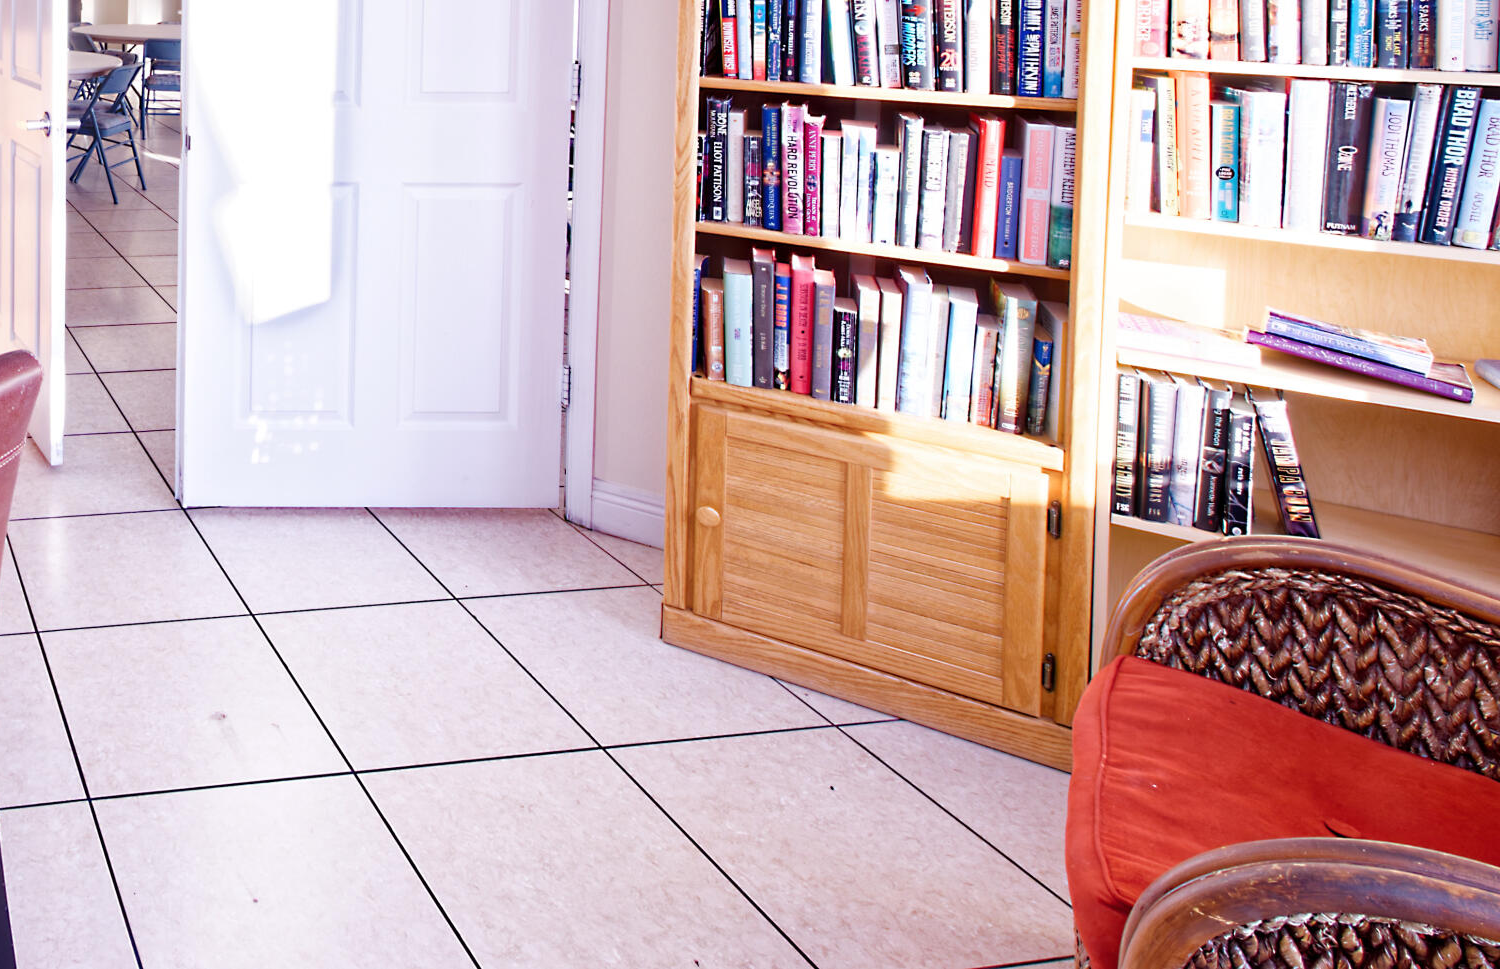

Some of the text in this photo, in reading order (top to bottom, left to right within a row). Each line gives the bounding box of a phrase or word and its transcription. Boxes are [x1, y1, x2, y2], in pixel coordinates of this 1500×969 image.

[1023, 10, 1042, 31] MICE
[1050, 5, 1060, 45] JAMES PATTERSON
[1358, 9, 1367, 27] SONG
[1418, 5, 1429, 31] SPARKS
[722, 22, 734, 52] DOWNSIZE
[804, 40, 815, 64] Lincoln
[902, 22, 916, 66] MURDERS
[997, 34, 1006, 73] DISAPPEAR
[1354, 34, 1362, 58] SPARKS
[1361, 29, 1371, 63] NICHOLAS
[1007, 51, 1015, 78] WOMEN
[716, 112, 727, 136] BONE
[1220, 108, 1234, 165] BRAD TAYLOR
[787, 135, 798, 161] HARD
[808, 130, 817, 172] ANNE PERRY
[1382, 112, 1403, 177] JODI THOMAS
[1435, 90, 1478, 228] BRAD THOR HIDDEN ORDER
[1477, 116, 1500, 179] BRAD THOR
[713, 141, 722, 202] ELIOT PATTISON
[984, 160, 996, 188] MAID
[1061, 132, 1077, 205] MATTHEW REILLY
[787, 163, 799, 219] REVOLUTION
[1006, 182, 1014, 215] BRIDGERTON
[767, 202, 776, 219] QUEEN
[1326, 222, 1356, 231] PUTNAM
[776, 303, 788, 327] ROBB
[1213, 417, 1224, 446] the Moon
[1115, 431, 1134, 498] PLEADING GUILTY
[1270, 439, 1312, 523] TAMPA BURN
[1116, 503, 1130, 512] FSG
[1206, 475, 1217, 516] Jeannette Walls
